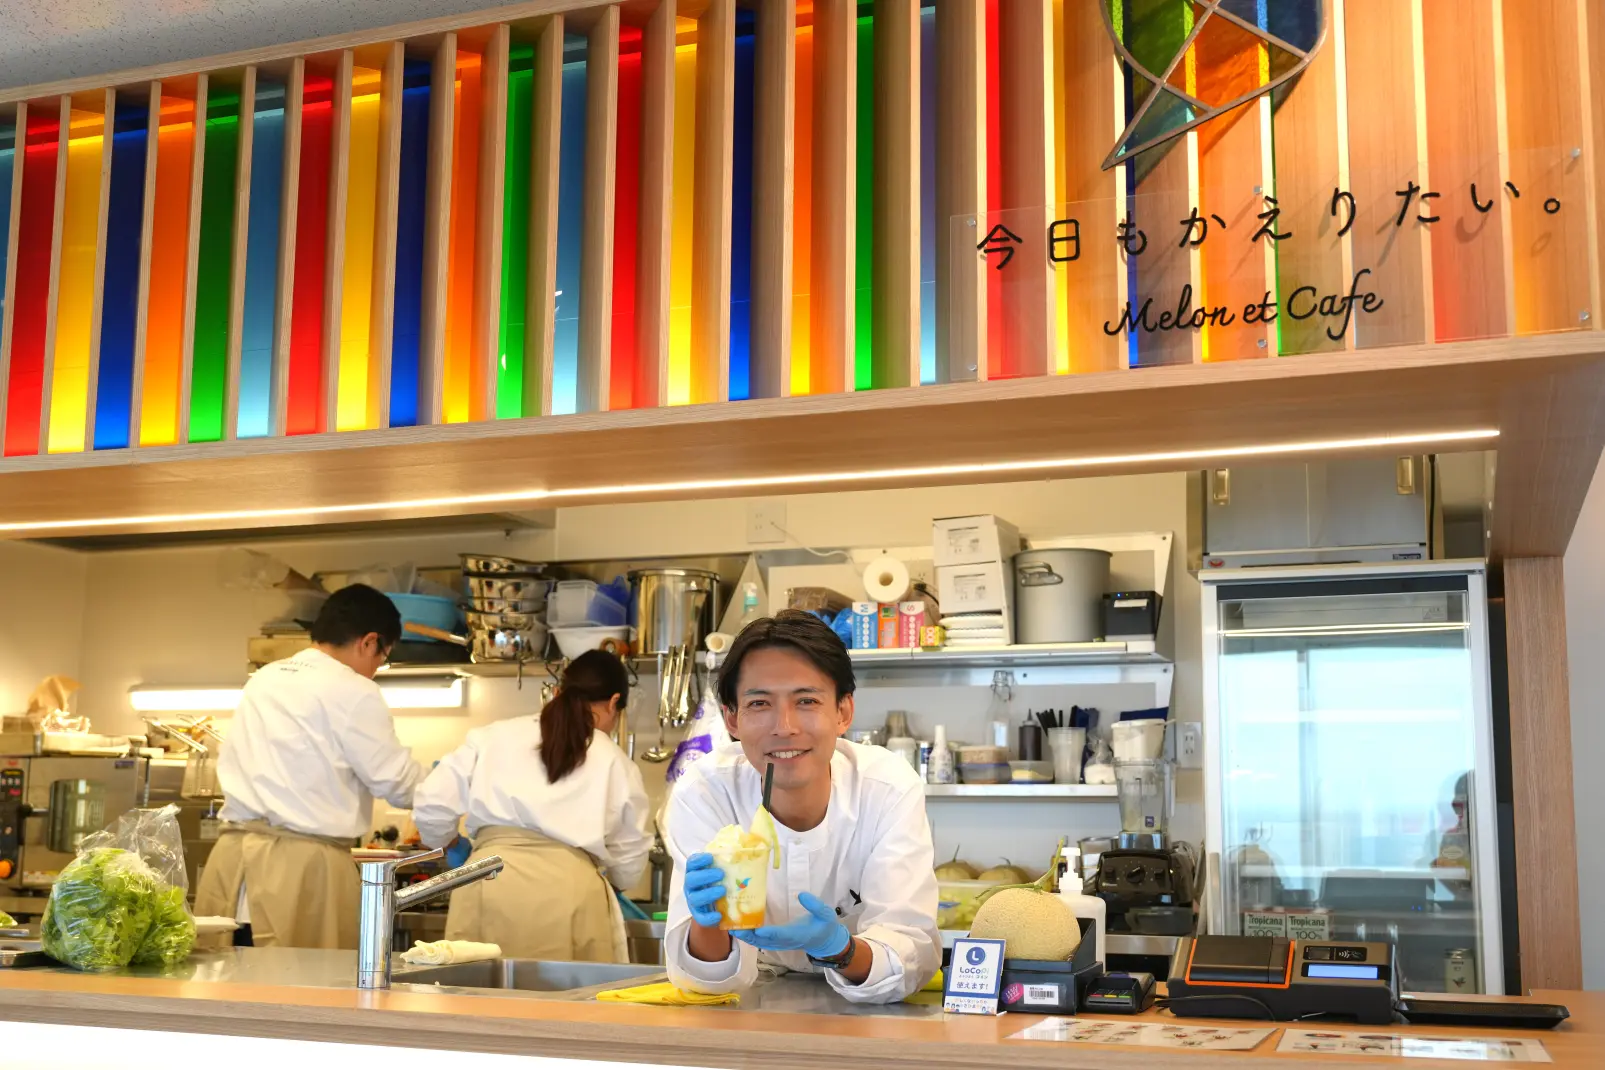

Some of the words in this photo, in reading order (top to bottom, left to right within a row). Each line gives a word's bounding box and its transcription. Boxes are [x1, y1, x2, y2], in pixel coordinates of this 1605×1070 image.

[976, 181, 1561, 270] 今日もかえりたい。
[1104, 284, 1235, 336] Melon
[1242, 291, 1278, 323] et
[1287, 268, 1384, 341] Cafe
[1248, 913, 1283, 926] Tropicana
[1288, 916, 1326, 928] Tropicana
